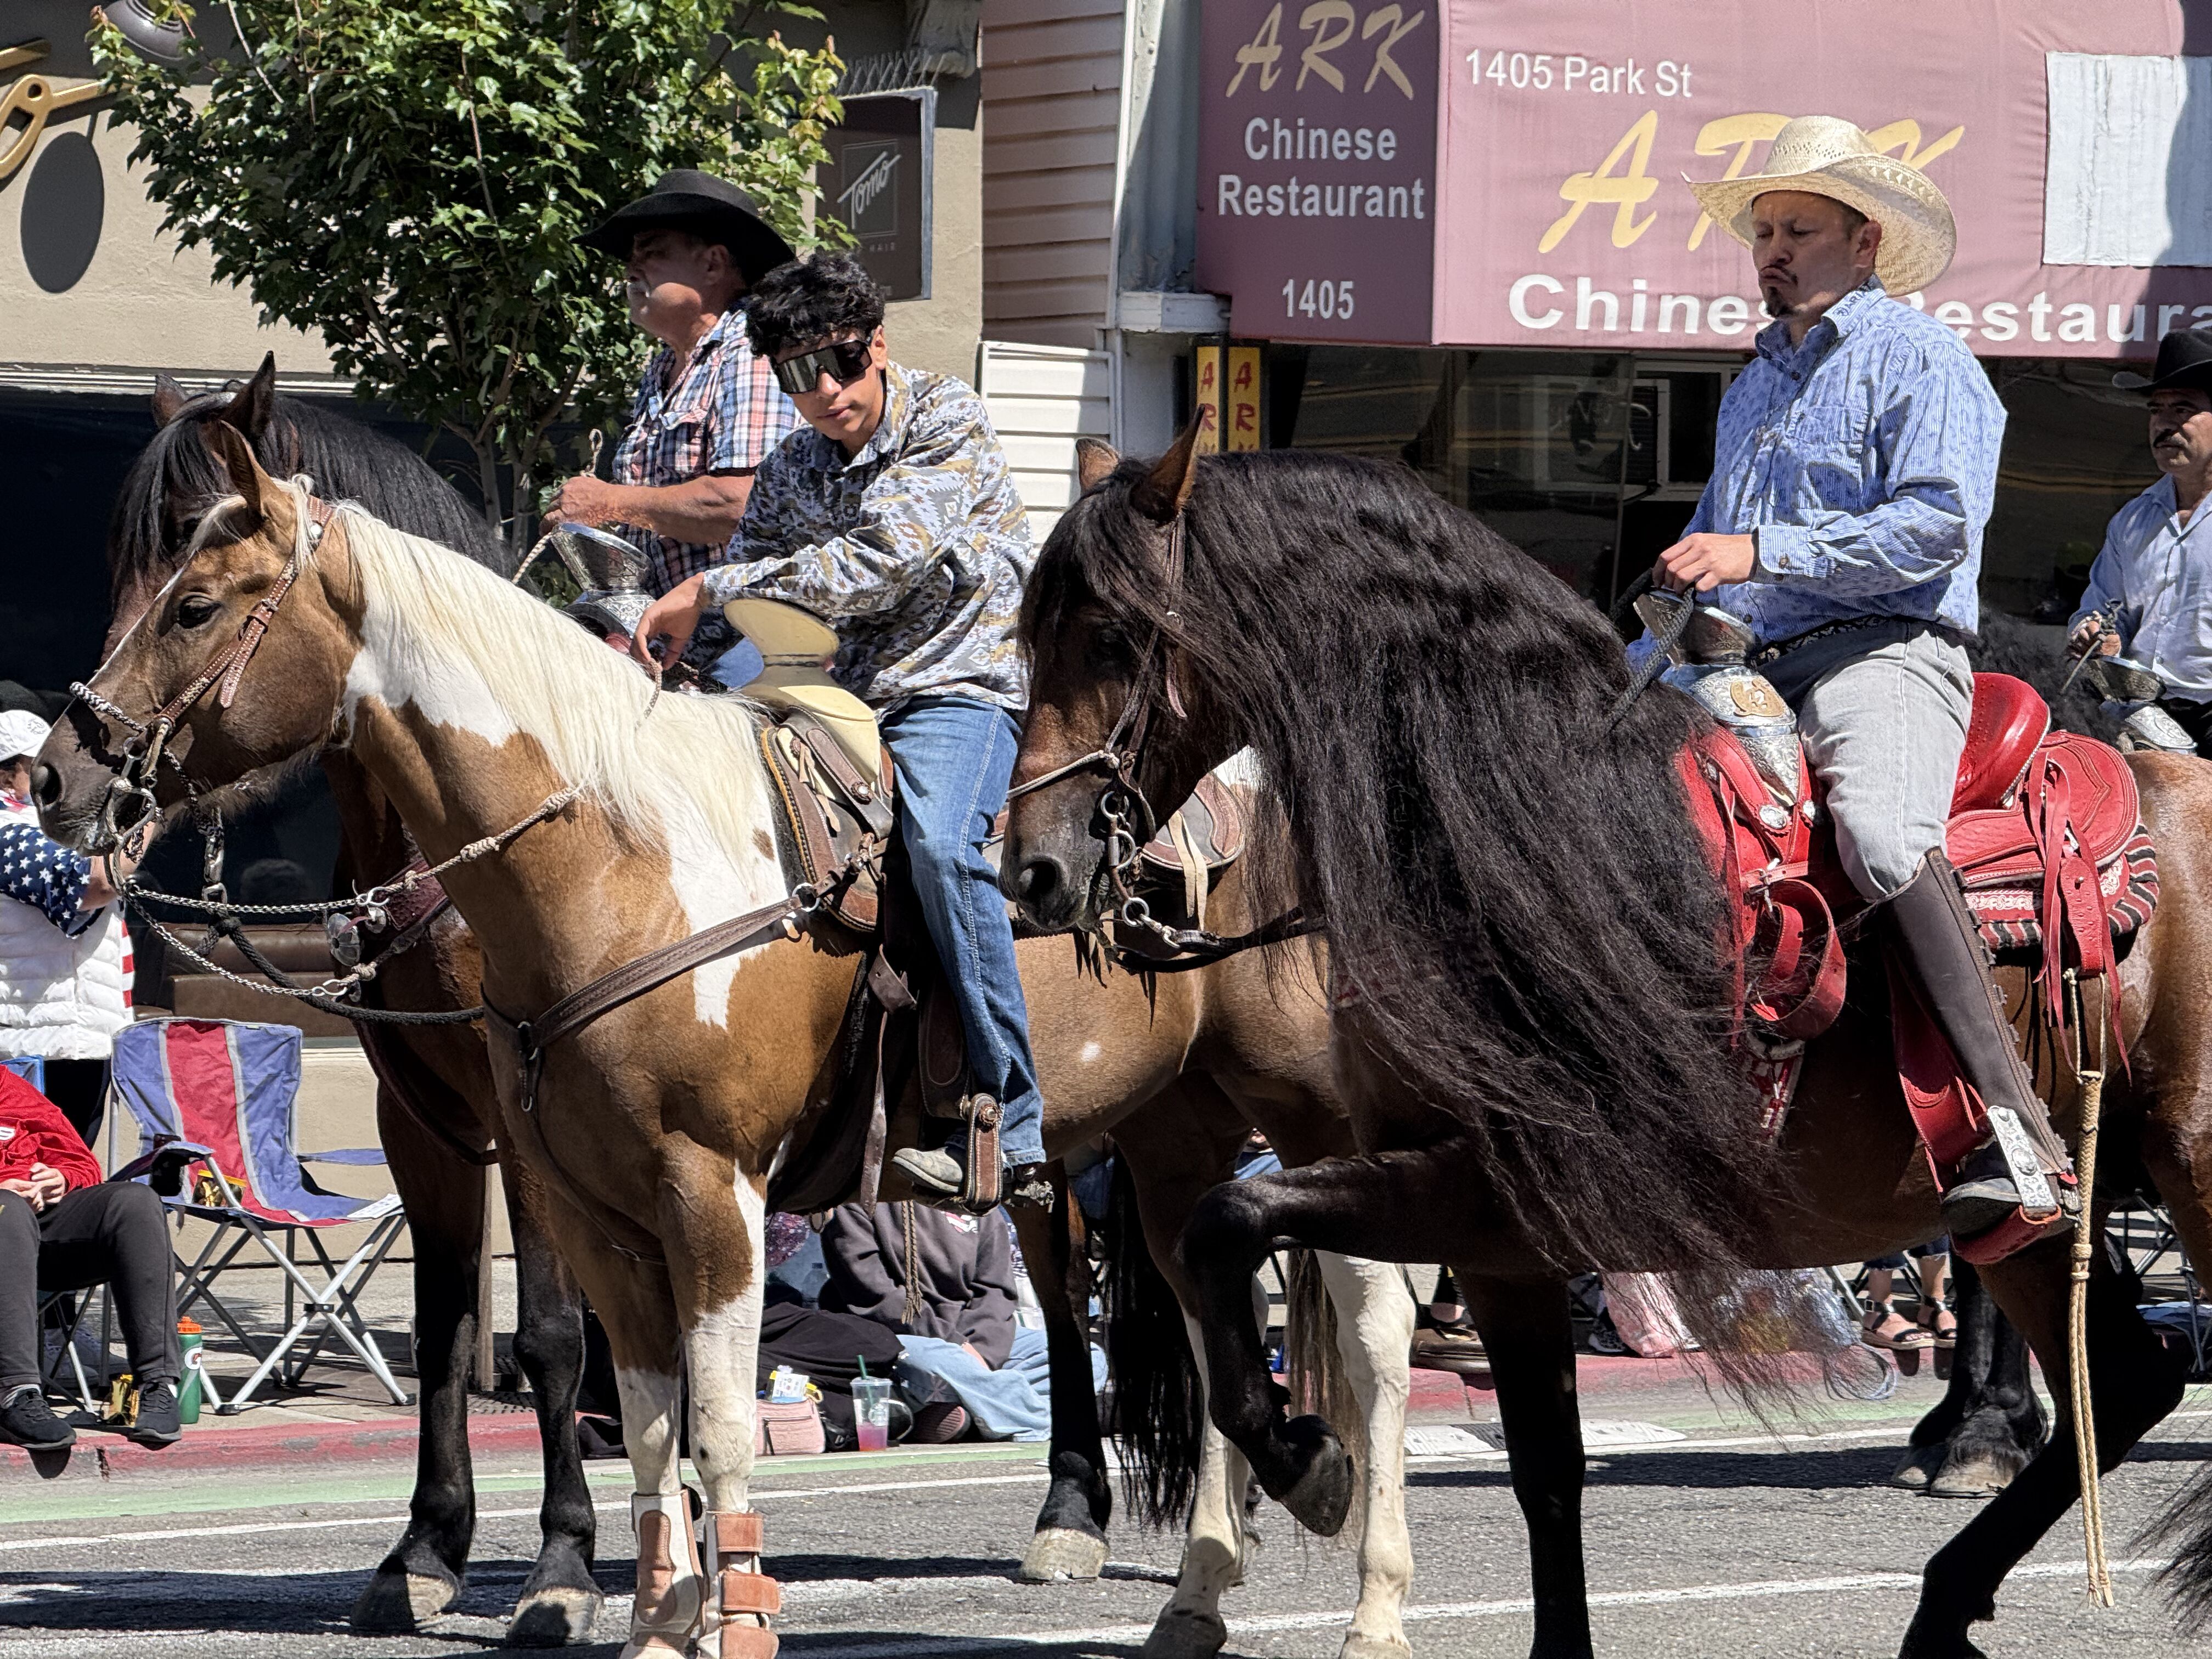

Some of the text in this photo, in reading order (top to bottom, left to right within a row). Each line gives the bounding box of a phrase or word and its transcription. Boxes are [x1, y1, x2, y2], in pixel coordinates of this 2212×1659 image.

[1226, 0, 1425, 100] ARK
[1466, 49, 1693, 98] 1405 Park St
[1245, 117, 1396, 160] Chinese
[1218, 175, 1425, 219] Restaurant
[1282, 279, 1355, 319] 1405
